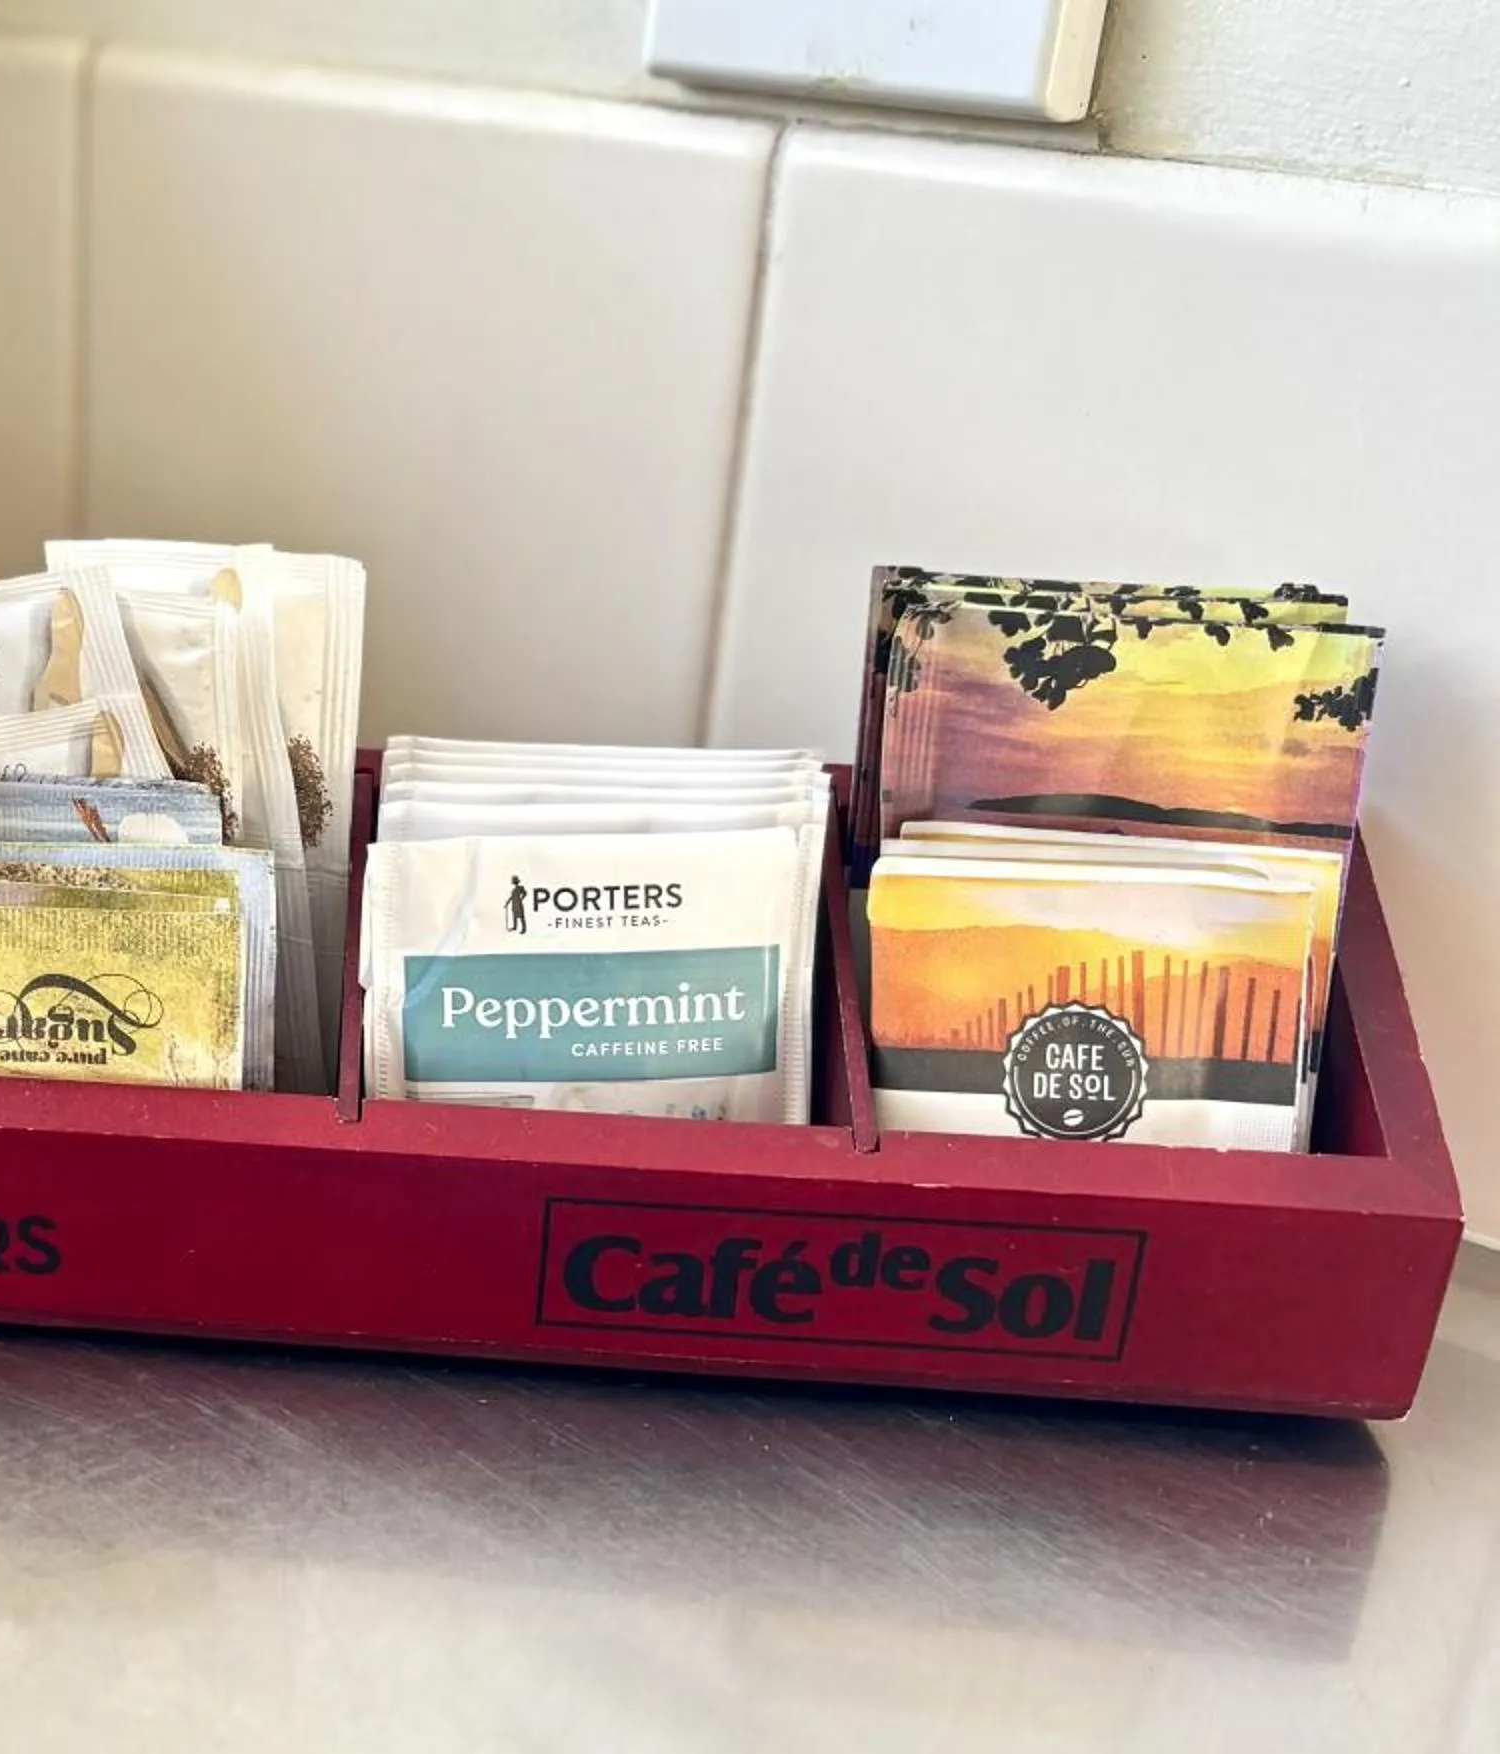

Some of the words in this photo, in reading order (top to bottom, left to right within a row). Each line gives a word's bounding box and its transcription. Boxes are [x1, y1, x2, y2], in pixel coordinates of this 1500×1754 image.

[533, 884, 684, 912] PORTERS
[441, 982, 746, 1040] Peppermint
[0, 1048, 51, 1063] cane
[56, 1048, 108, 1065] pure
[571, 1041, 669, 1057] CAFFEINE
[677, 1038, 725, 1054] FREE
[1045, 1043, 1105, 1072] CAFE
[1033, 1072, 1062, 1099] DE
[562, 1233, 823, 1324] Café
[830, 1231, 932, 1291] de
[926, 1256, 1118, 1341] Sol
